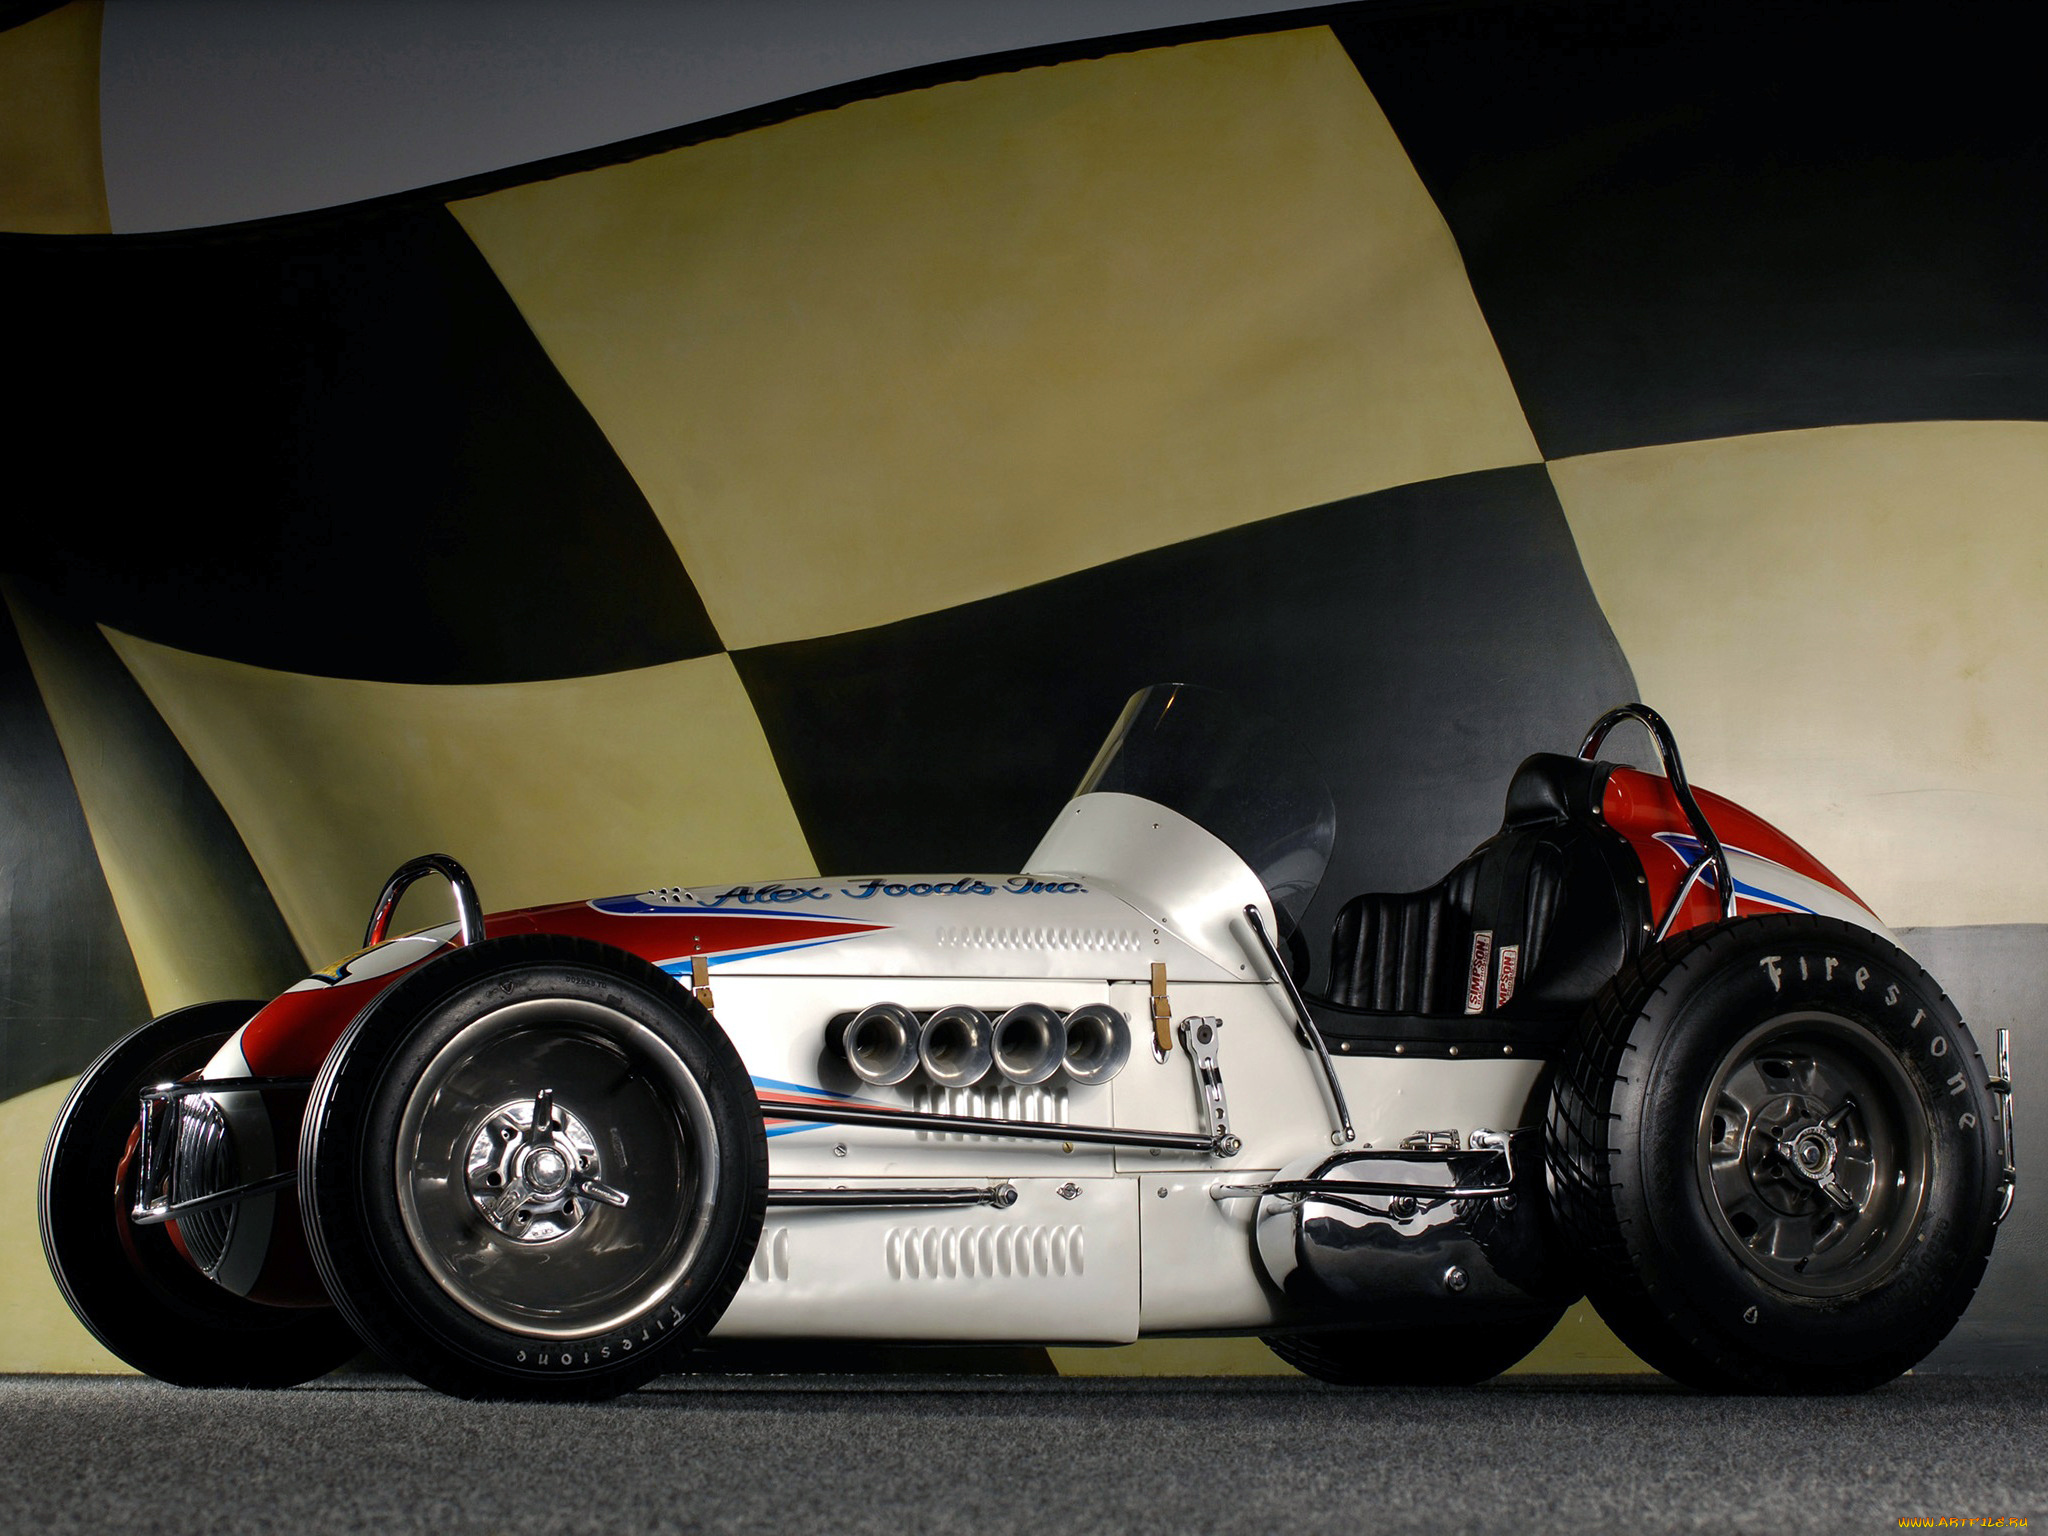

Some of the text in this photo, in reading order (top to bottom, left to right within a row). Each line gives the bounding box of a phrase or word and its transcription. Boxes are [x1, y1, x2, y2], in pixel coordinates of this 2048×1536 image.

[698, 876, 1089, 908] Alex Foods Inc.
[1469, 940, 1485, 1005] SIMPSON
[1499, 956, 1512, 1006] MPSON
[1759, 955, 1977, 1130] Firestone
[516, 1305, 687, 1366] Firestone
